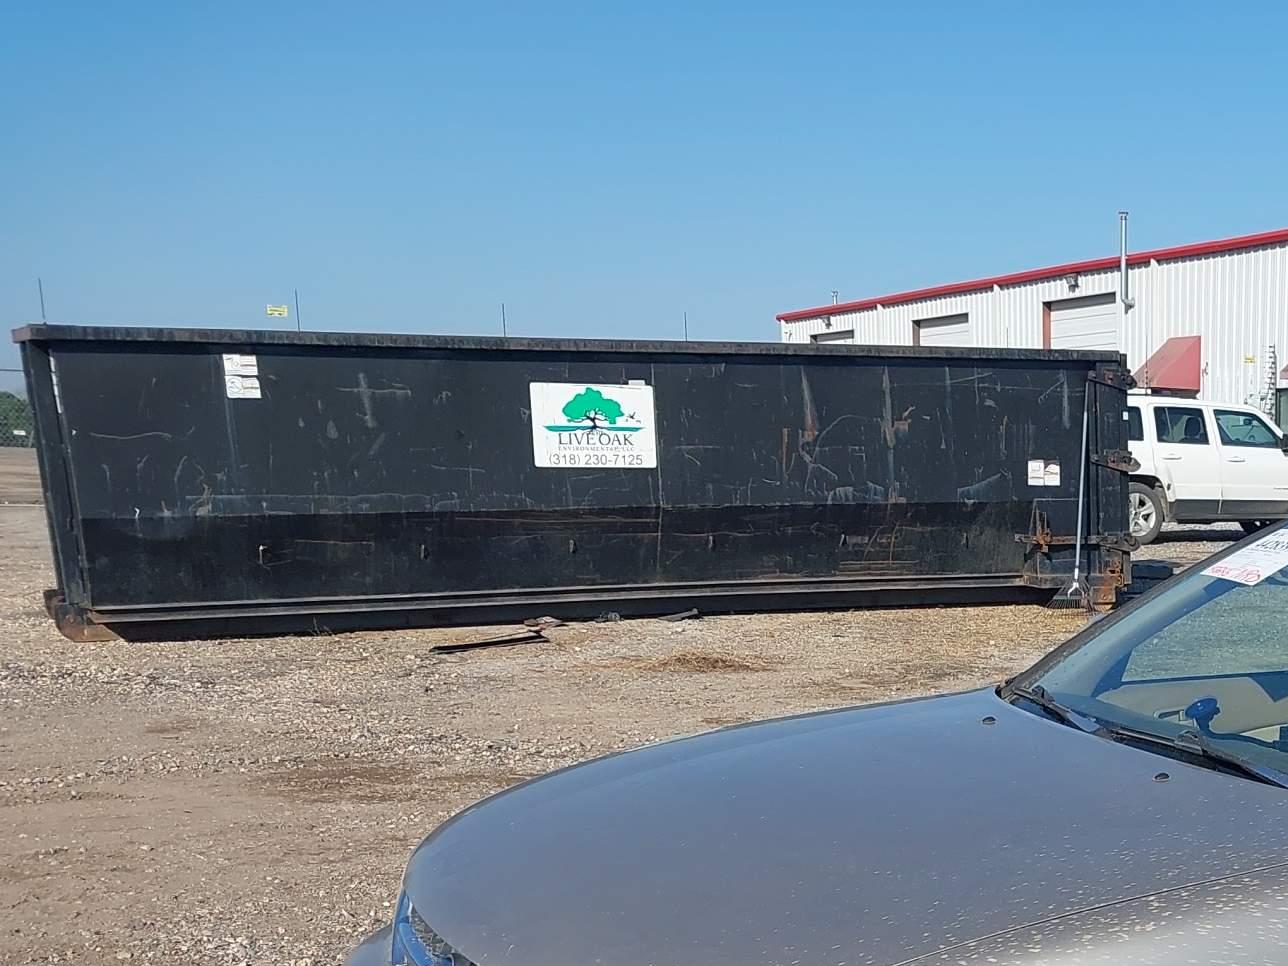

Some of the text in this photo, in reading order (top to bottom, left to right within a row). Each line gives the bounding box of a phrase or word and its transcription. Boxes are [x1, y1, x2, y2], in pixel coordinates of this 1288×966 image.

[558, 432, 635, 447] LIVE OAK
[549, 453, 643, 466] (318) 230-7125
